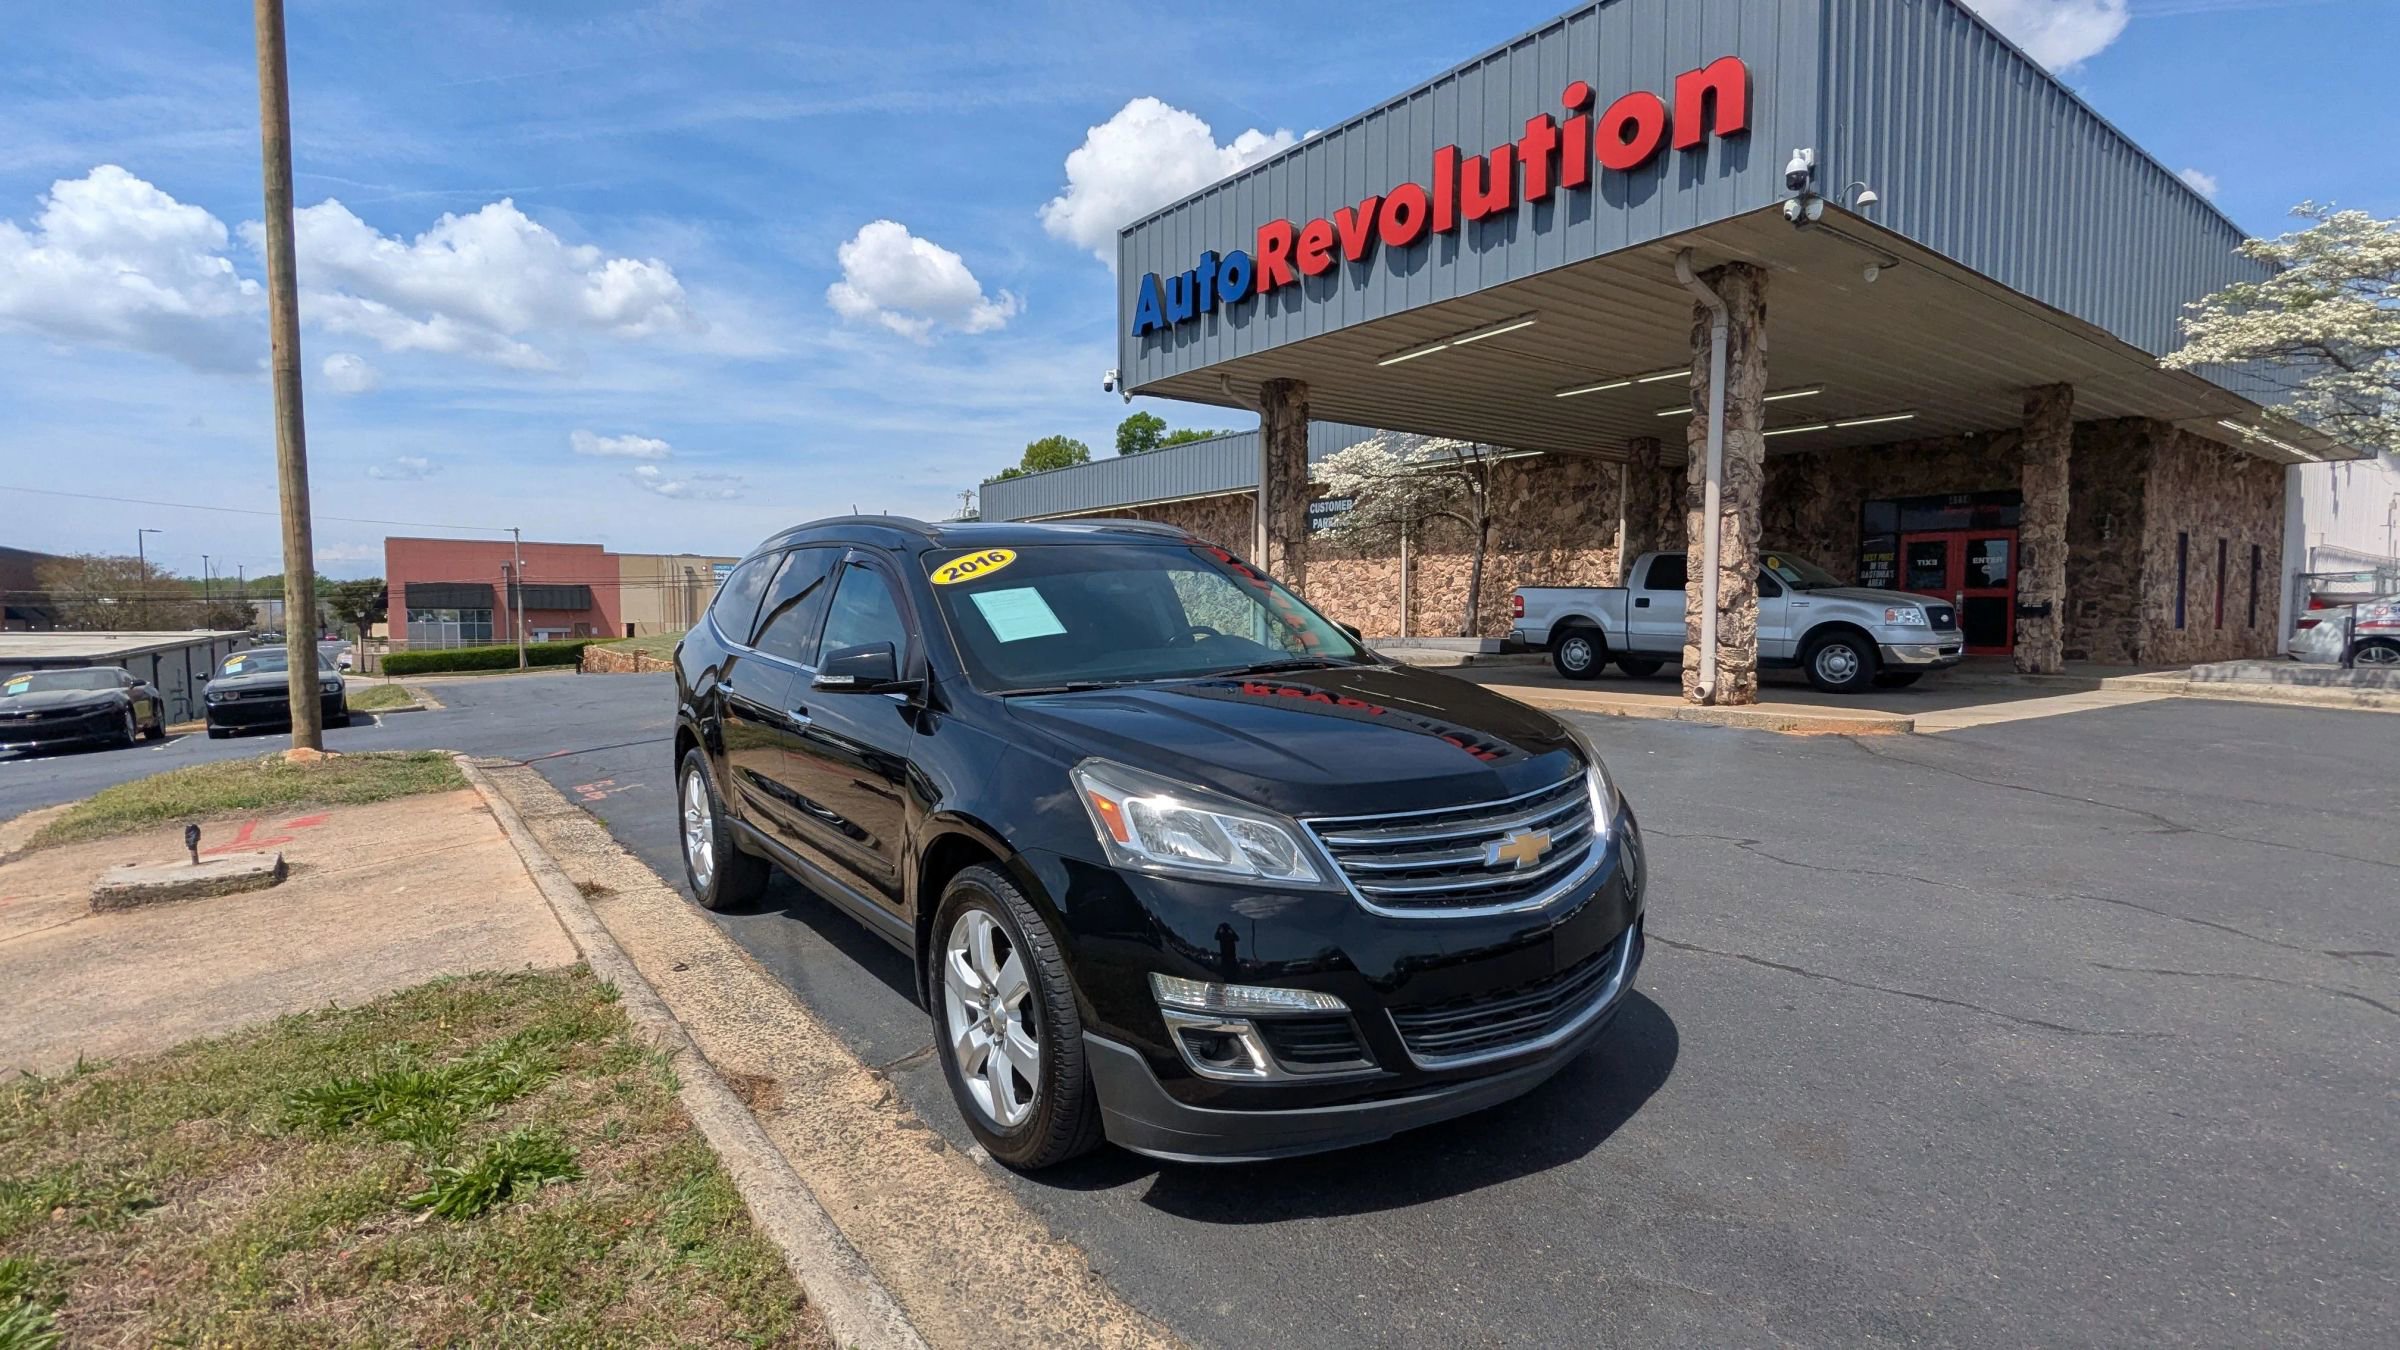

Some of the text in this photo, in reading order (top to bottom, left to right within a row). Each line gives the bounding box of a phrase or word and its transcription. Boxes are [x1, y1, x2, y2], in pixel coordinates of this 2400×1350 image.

[1309, 499, 1352, 514] CUSTOMER
[1312, 516, 1350, 529] PARKG
[943, 551, 1006, 580] 2016
[1972, 556, 2002, 564] ENTER
